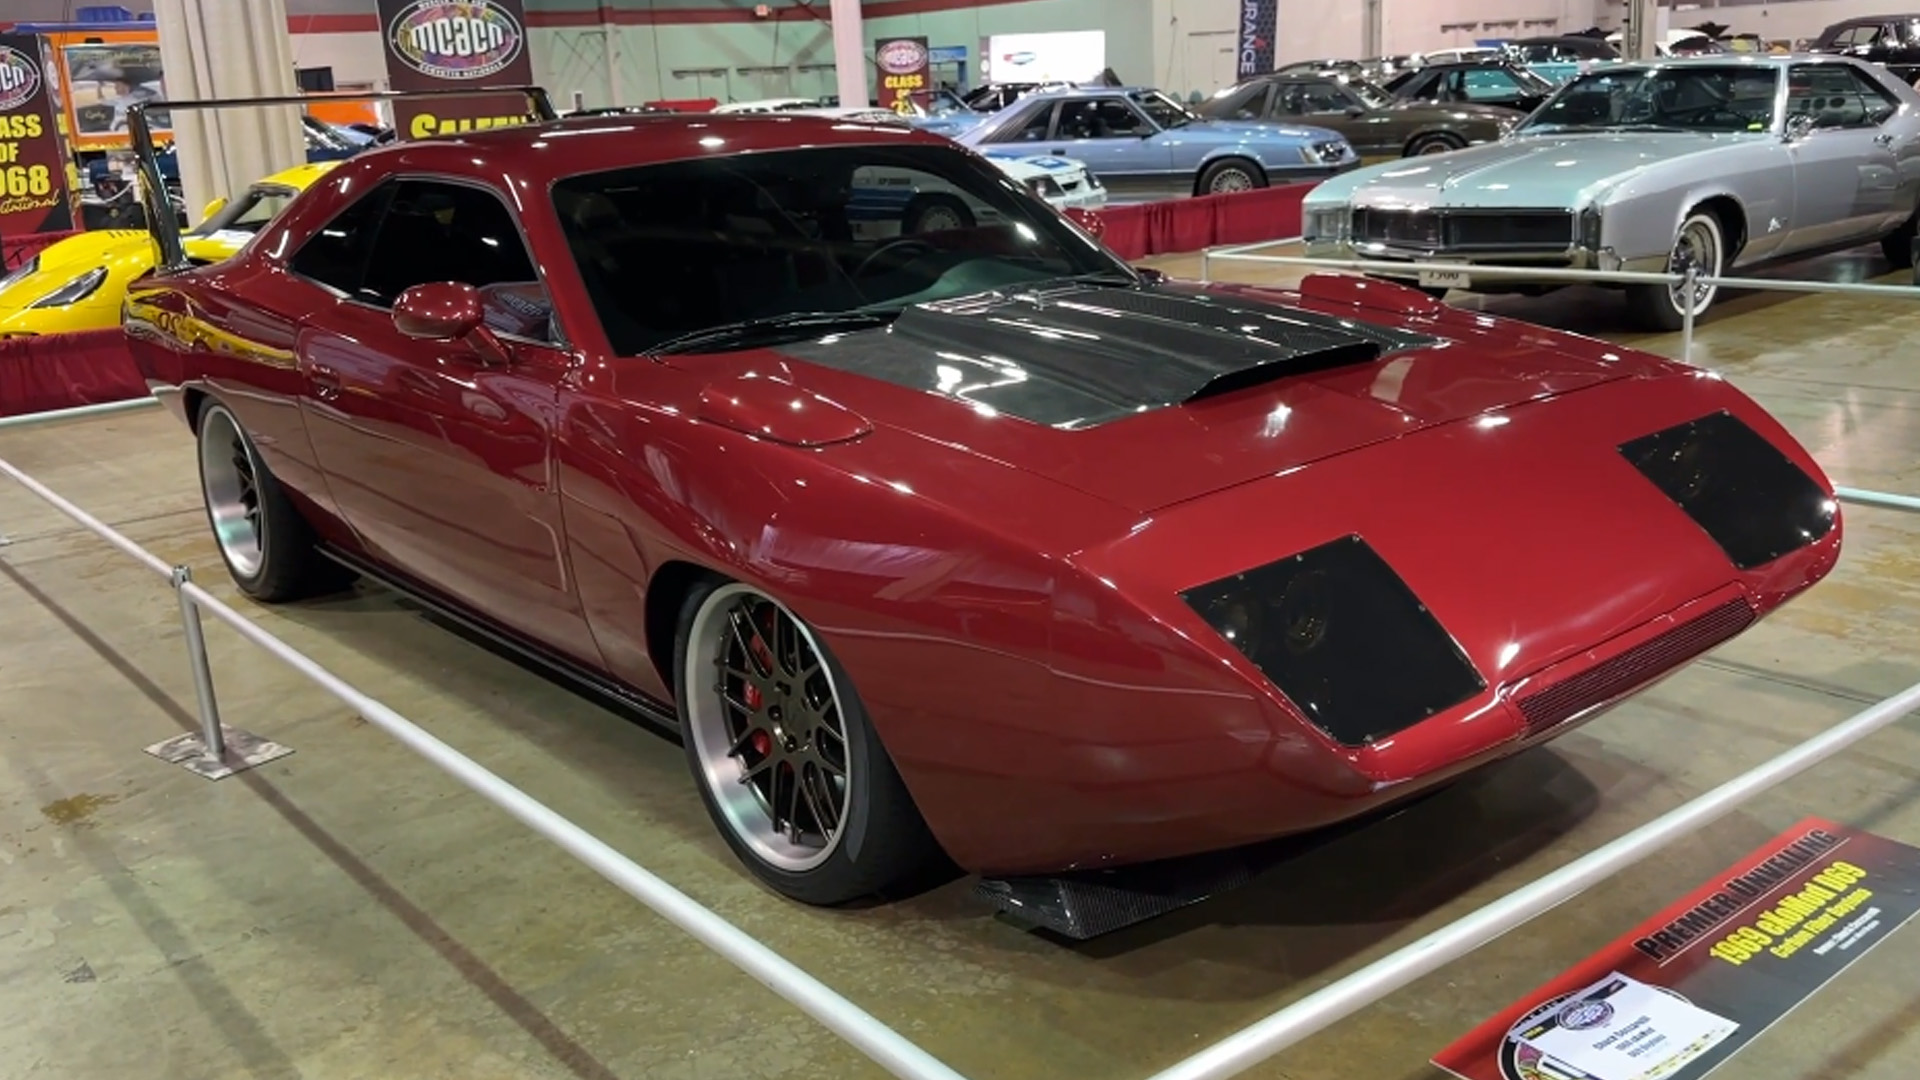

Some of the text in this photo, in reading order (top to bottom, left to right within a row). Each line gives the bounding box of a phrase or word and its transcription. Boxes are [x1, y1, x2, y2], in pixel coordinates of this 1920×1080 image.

[1241, 0, 1258, 74] URANCE
[1632, 891, 1741, 961] PREMIER
[1723, 827, 1840, 898] UNVEILING
[1710, 926, 1773, 966] 1969
[1813, 861, 1867, 892] D69
